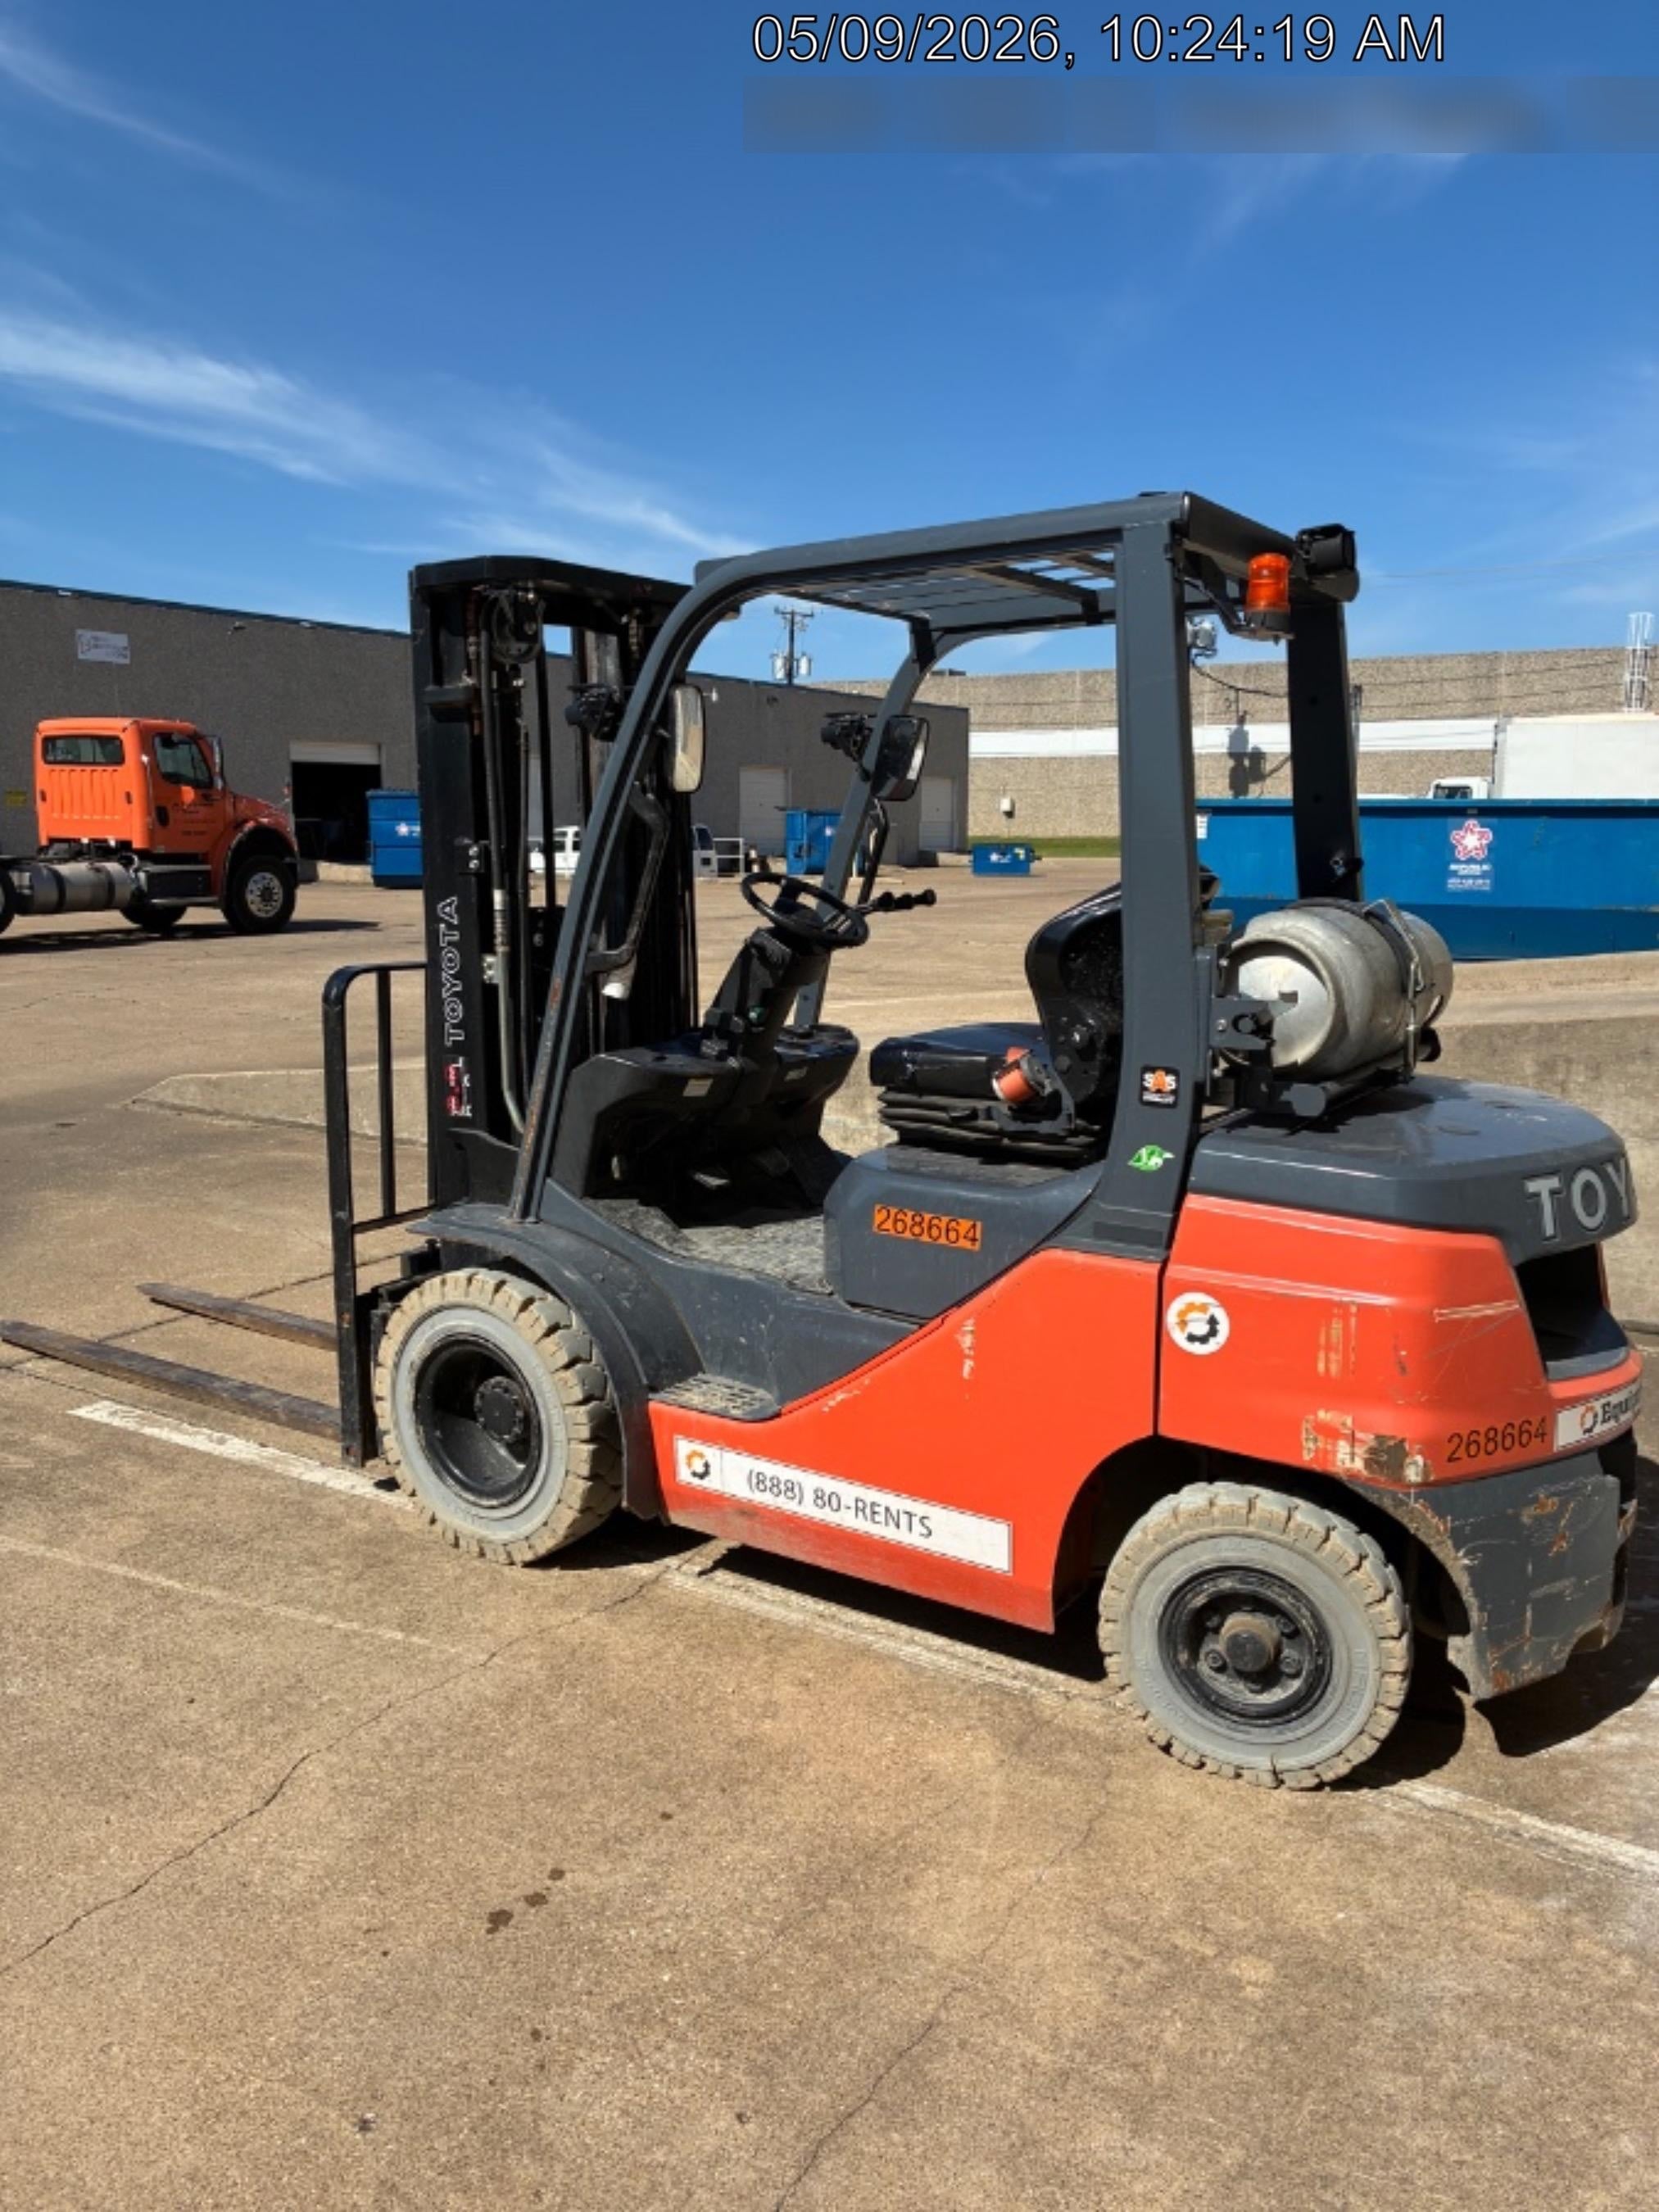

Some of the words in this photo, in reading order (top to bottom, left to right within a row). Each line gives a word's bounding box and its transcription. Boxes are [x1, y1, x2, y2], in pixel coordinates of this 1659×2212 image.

[437, 895, 465, 1048] TOYOTA
[876, 1205, 979, 1246] 268664
[1447, 1416, 1548, 1463] 268664
[746, 1469, 804, 1506] (888)
[813, 1487, 933, 1539] 80-RENTS
